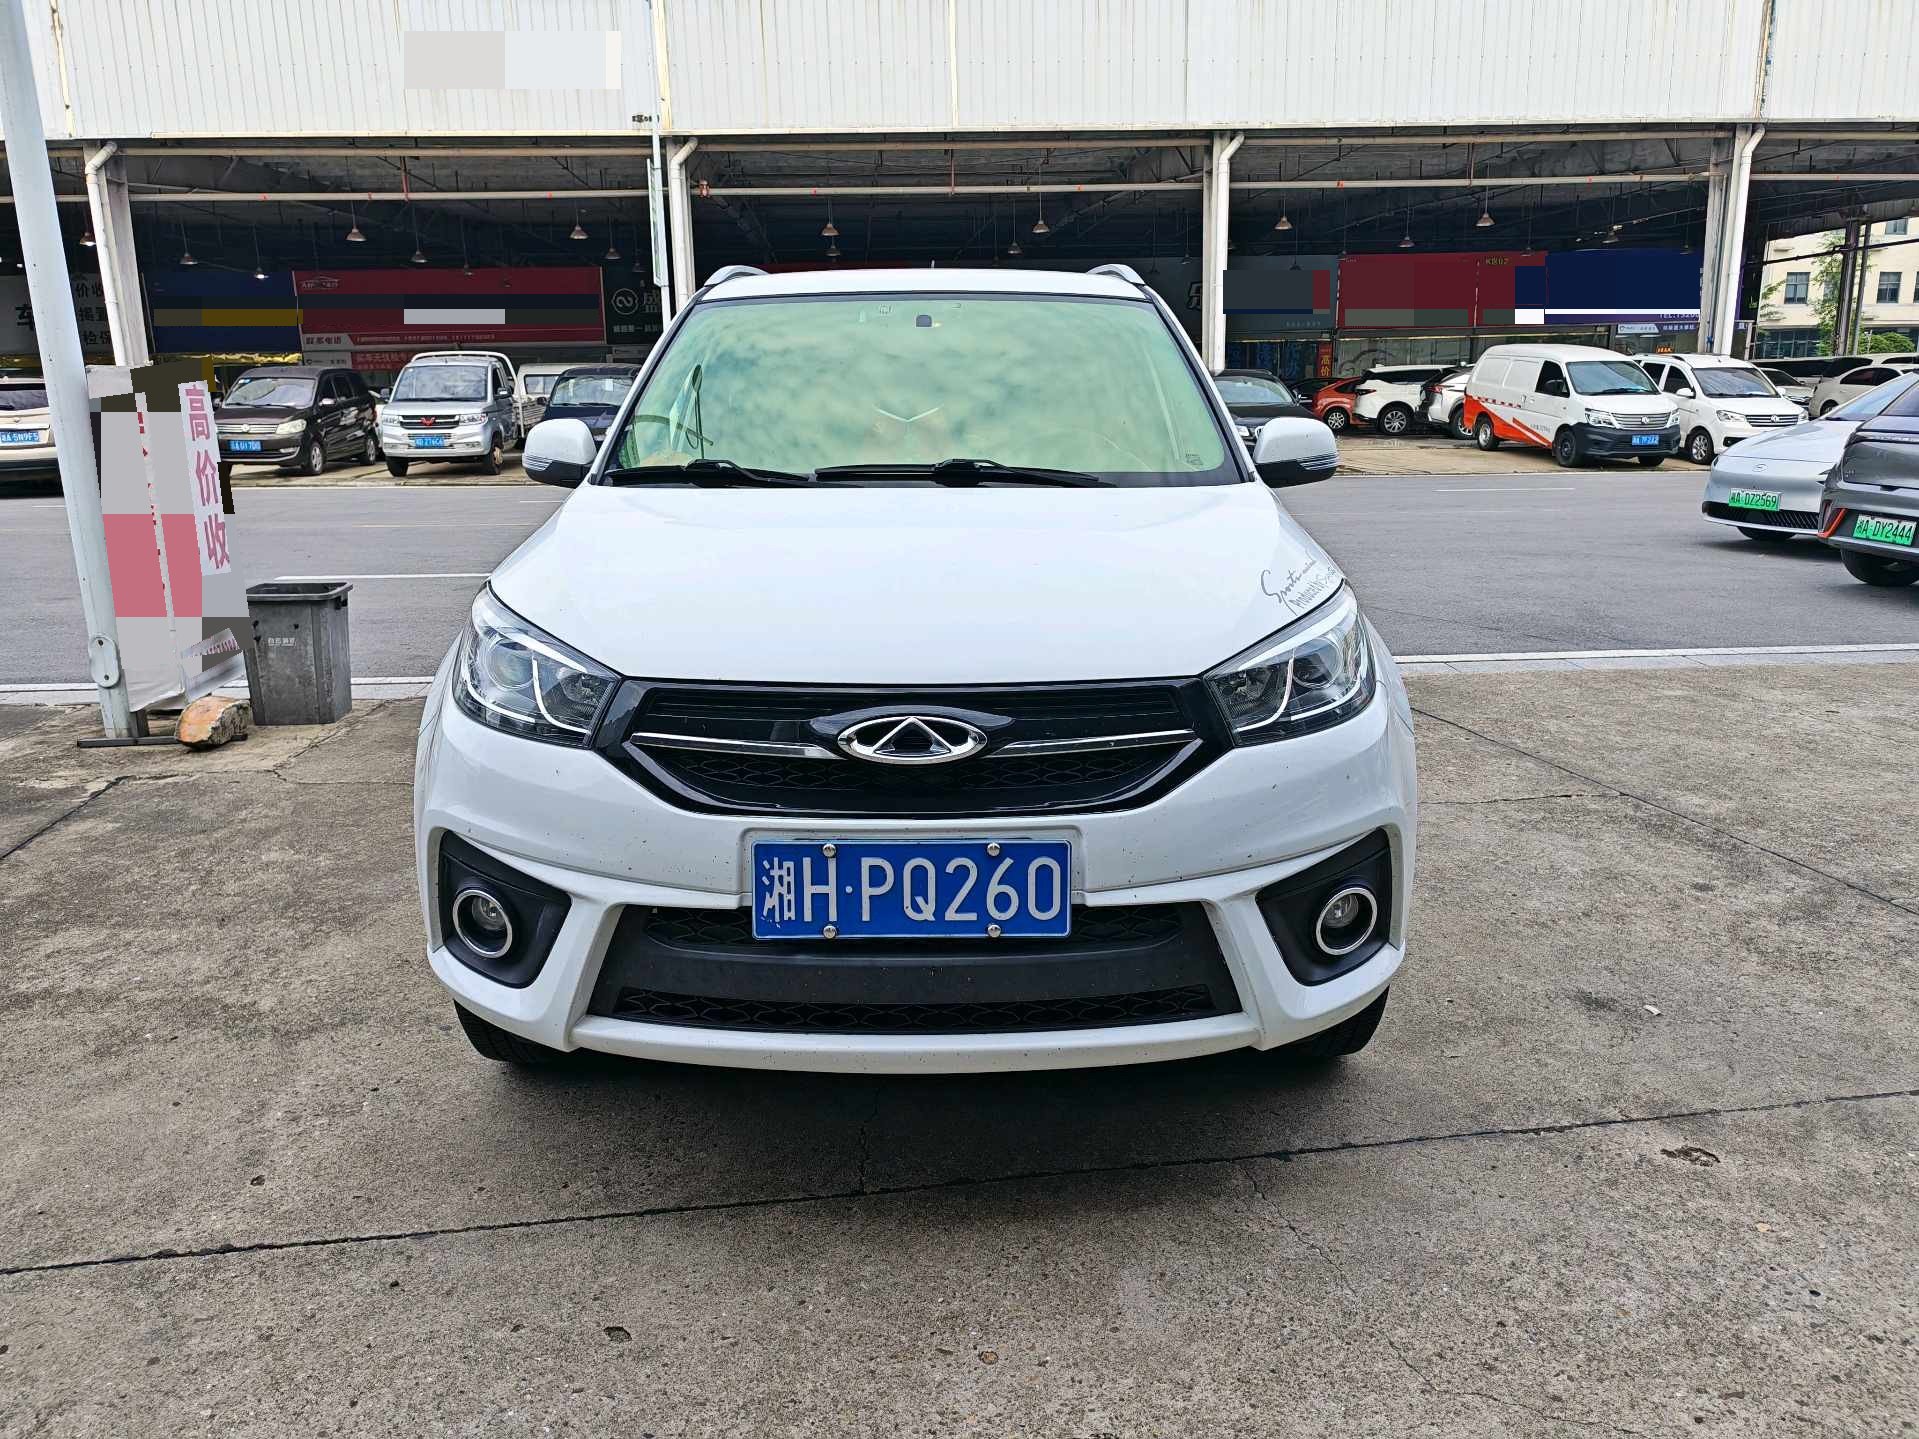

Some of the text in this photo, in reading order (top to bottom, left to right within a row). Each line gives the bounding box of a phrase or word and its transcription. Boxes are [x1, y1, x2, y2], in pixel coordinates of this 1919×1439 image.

[185, 384, 230, 570] 高价收
[761, 856, 1062, 926] 湘H·PQ260
